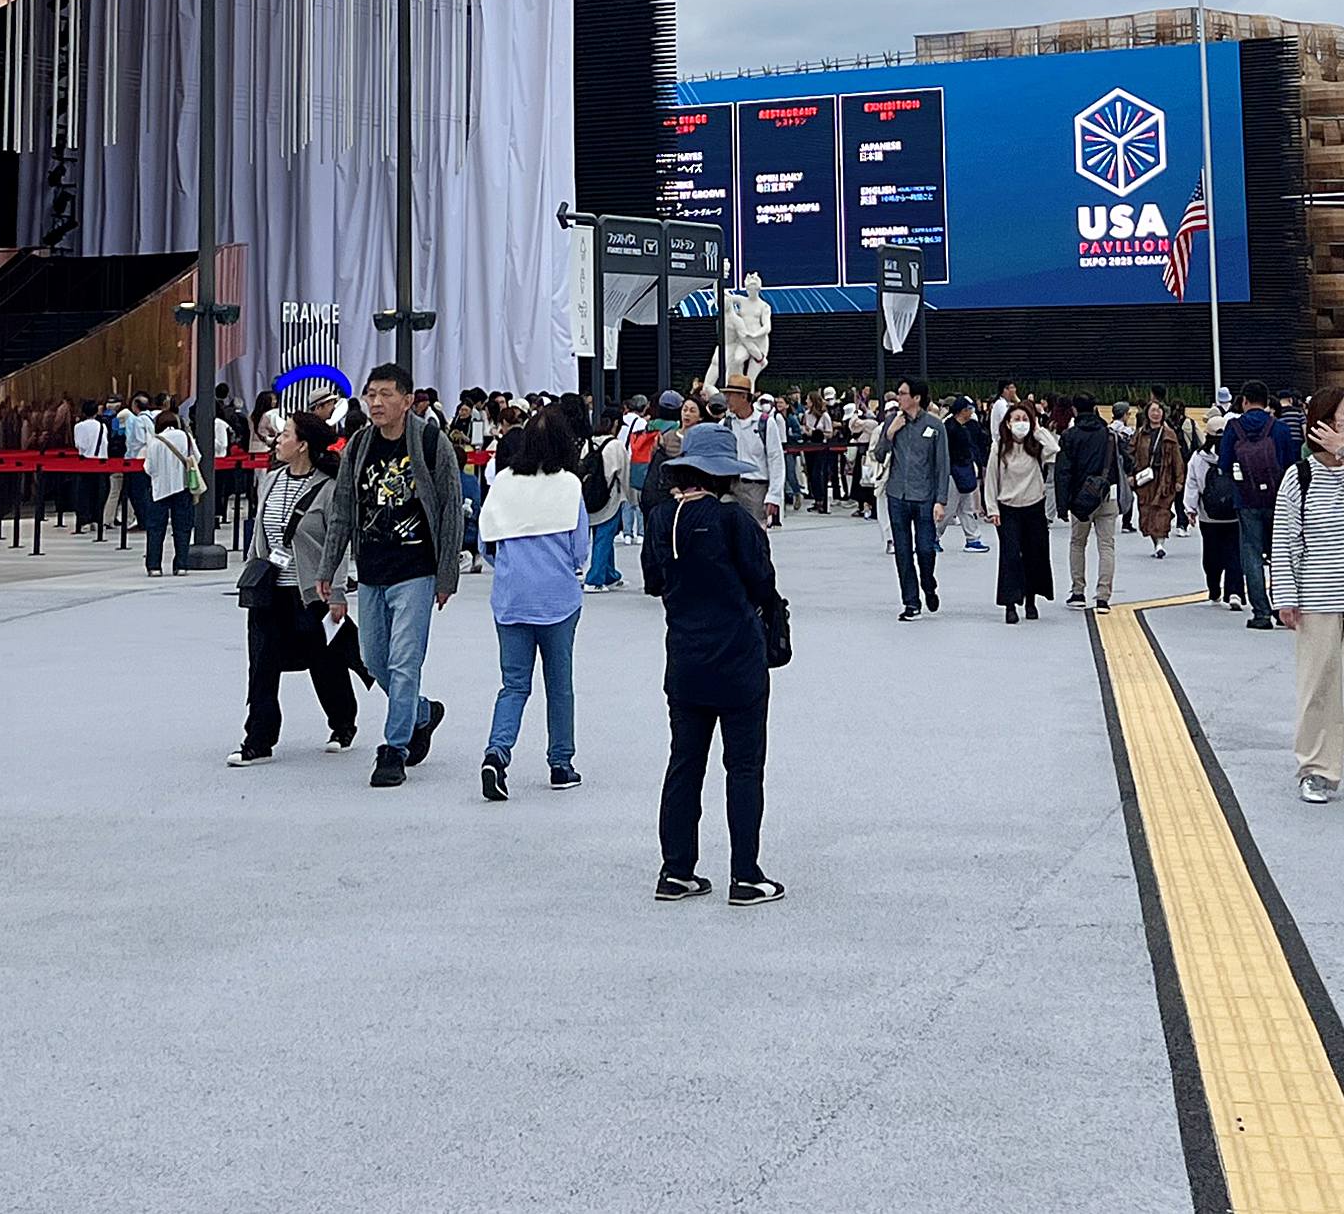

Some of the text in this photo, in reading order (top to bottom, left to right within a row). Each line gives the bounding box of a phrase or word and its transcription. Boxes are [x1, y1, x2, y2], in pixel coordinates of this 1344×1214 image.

[859, 141, 902, 152] JAPANESE
[1077, 203, 1169, 240] USA
[1079, 239, 1171, 255] PAVILION
[1079, 255, 1169, 268] EXPO 2025 OSAKA
[282, 301, 340, 324] FRANCE
